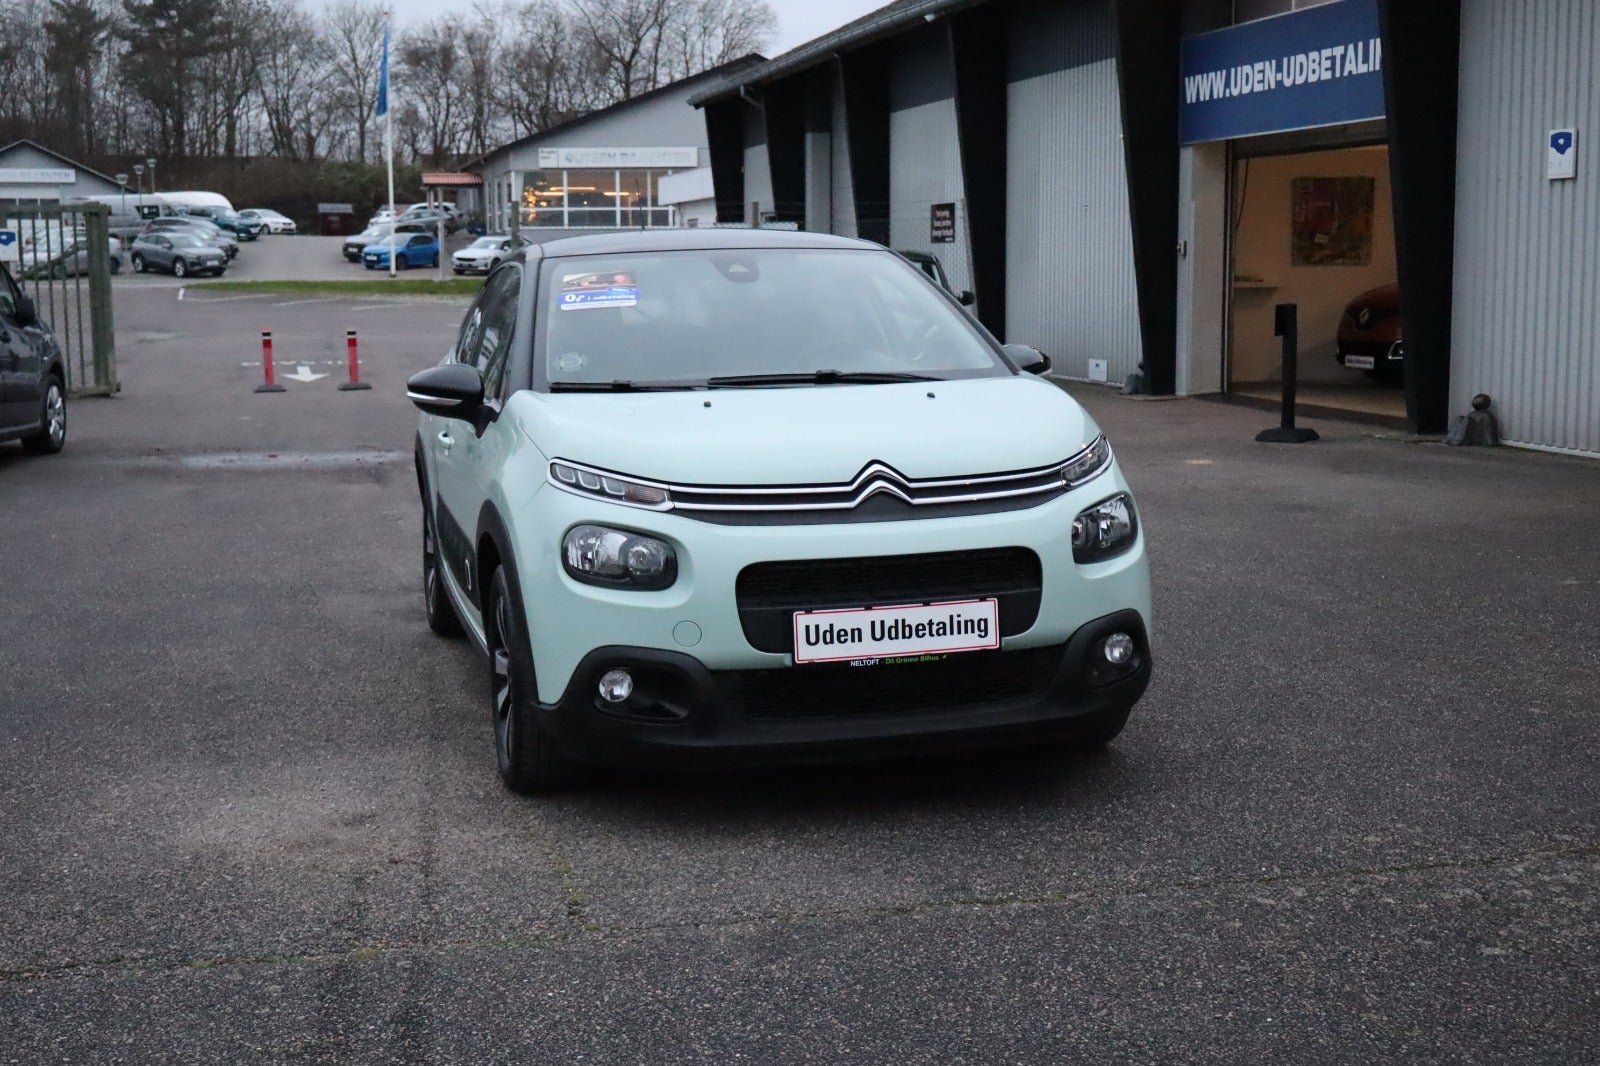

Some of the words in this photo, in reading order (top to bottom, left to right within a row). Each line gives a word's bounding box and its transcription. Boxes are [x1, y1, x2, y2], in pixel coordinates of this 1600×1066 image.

[805, 623, 863, 646] Uden
[870, 614, 989, 642] Udbetaling
[850, 659, 880, 667] NELTOFT
